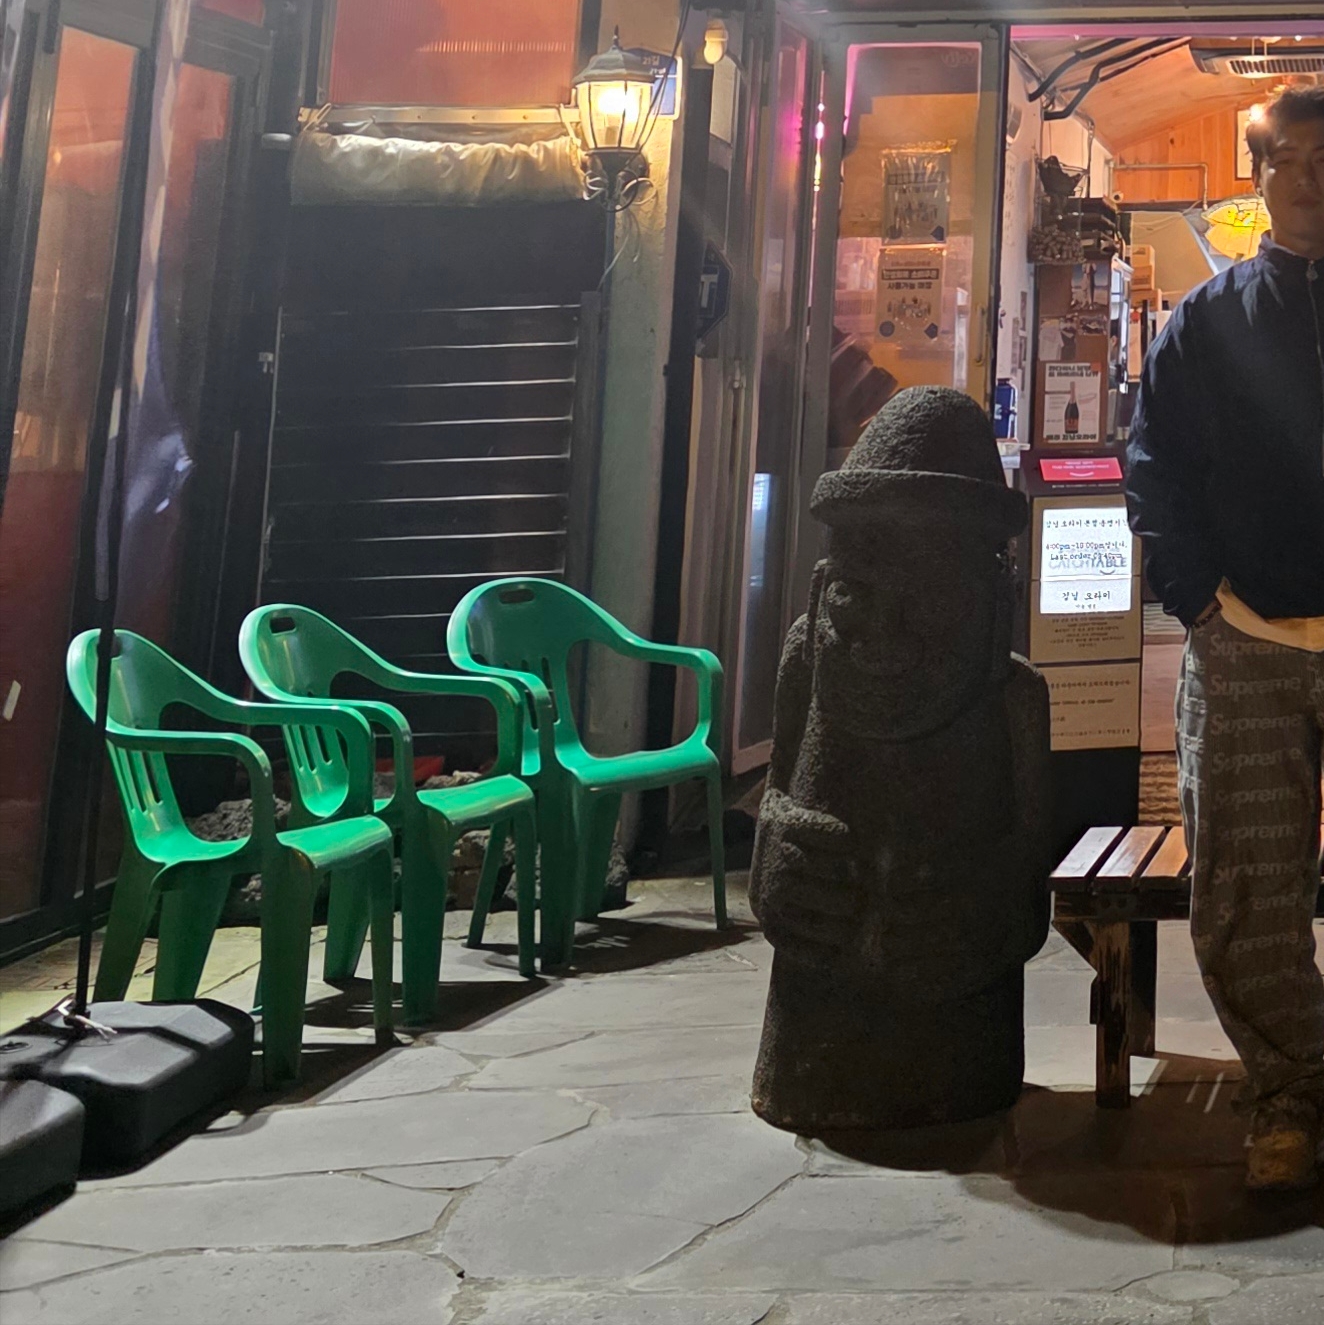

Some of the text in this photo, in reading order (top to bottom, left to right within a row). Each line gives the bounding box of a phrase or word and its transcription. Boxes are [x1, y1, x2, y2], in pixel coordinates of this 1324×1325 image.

[1210, 633, 1297, 663] Suprem
[1210, 675, 1301, 701] Supreme
[1211, 713, 1302, 736] Supreme
[1213, 748, 1302, 774] Supreme
